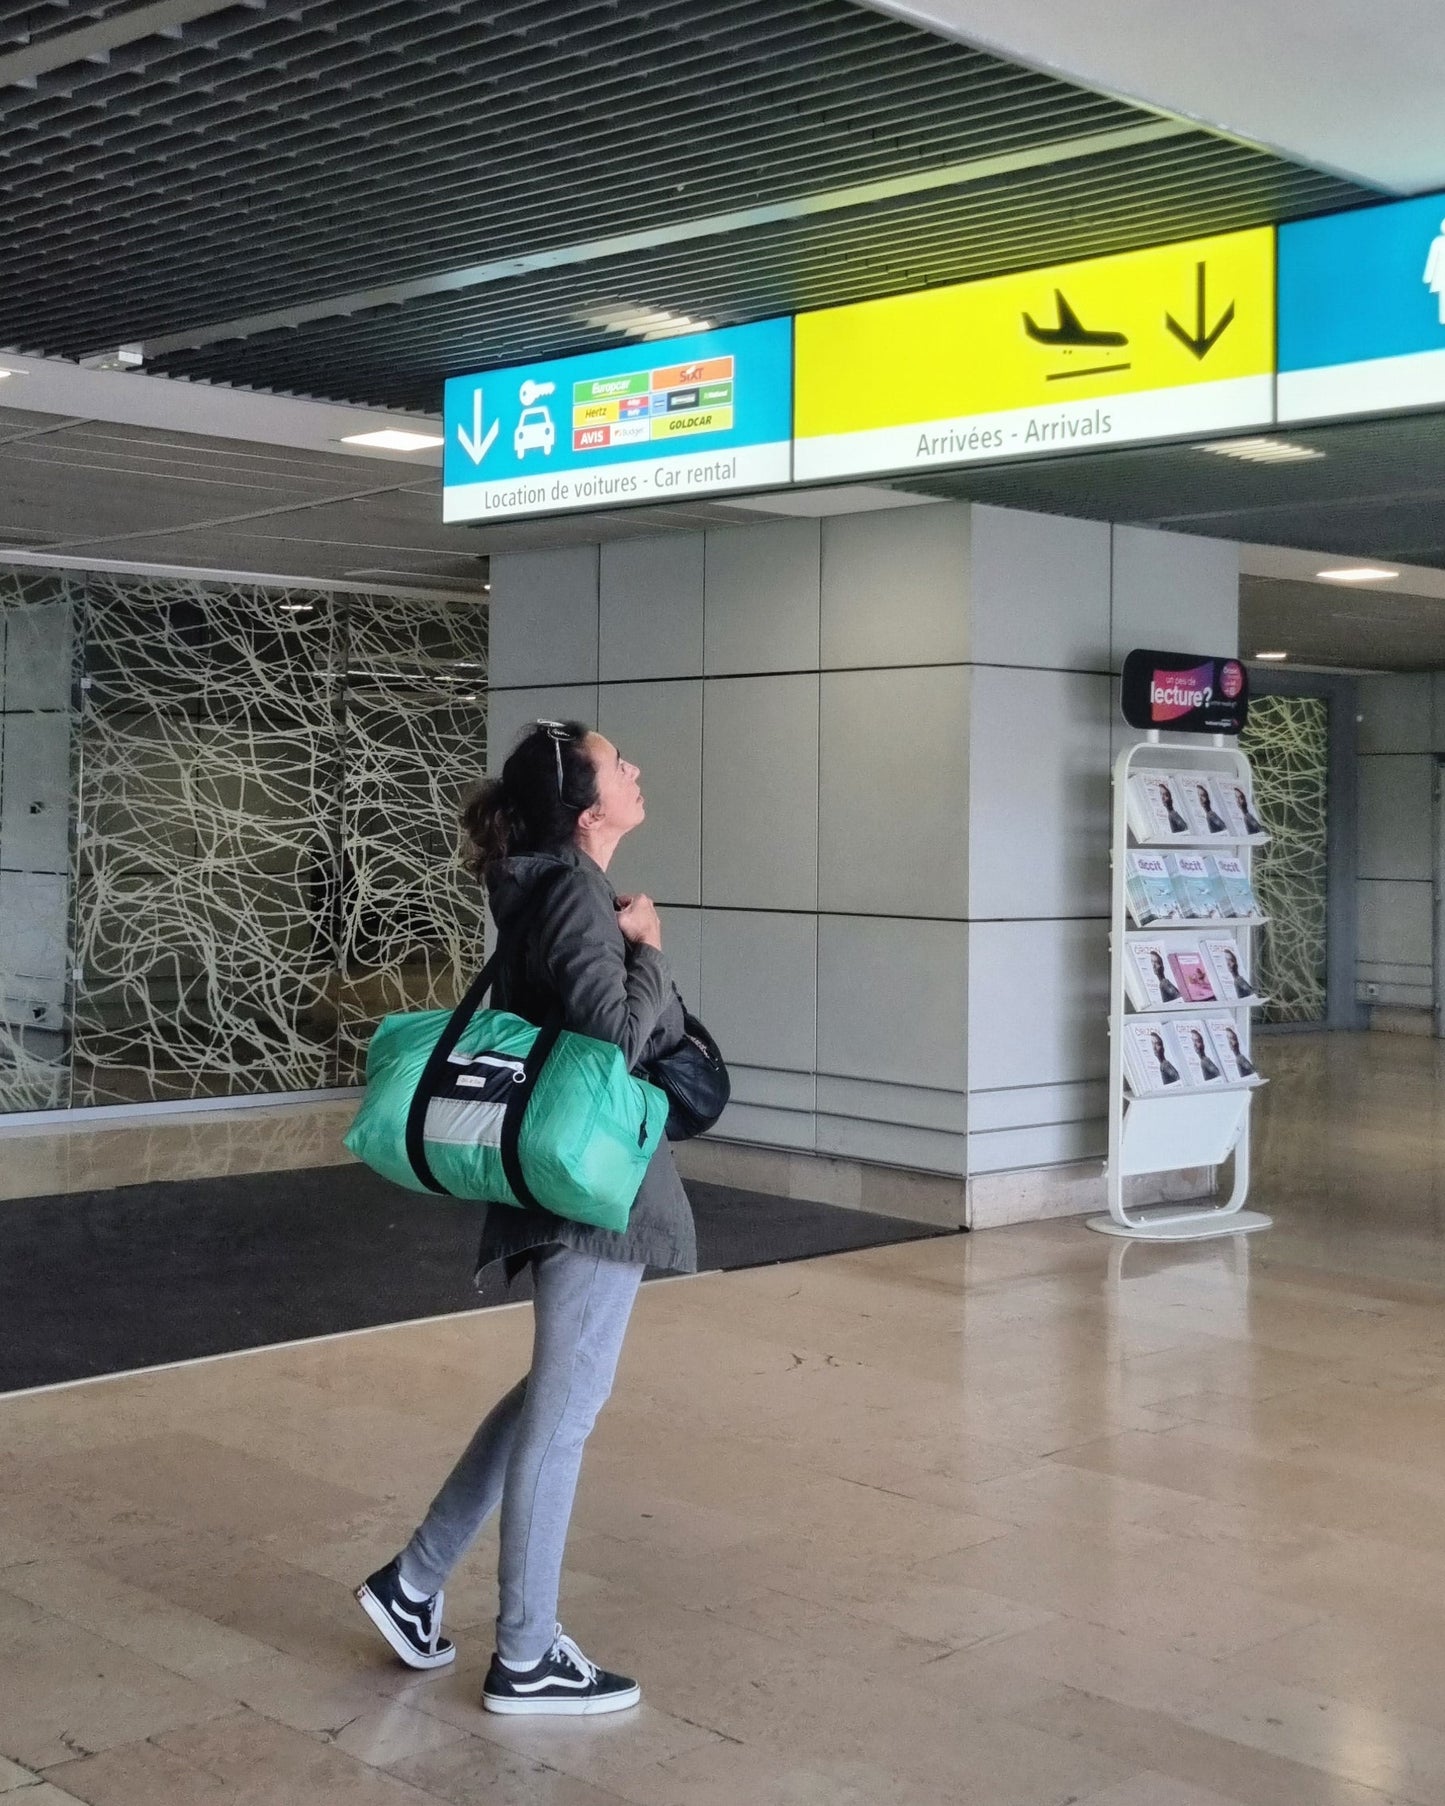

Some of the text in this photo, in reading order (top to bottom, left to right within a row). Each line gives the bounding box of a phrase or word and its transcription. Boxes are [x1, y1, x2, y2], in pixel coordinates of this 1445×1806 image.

[591, 379, 631, 395] Europcar
[585, 407, 607, 418] Hertz
[669, 415, 712, 430] GOLDCAR
[580, 430, 604, 445] AVIS
[916, 426, 1003, 457] Arrivées
[1024, 409, 1112, 443] Arrivals
[484, 485, 546, 510] Location
[551, 480, 569, 500] de
[574, 475, 638, 498] voitures
[654, 467, 681, 488] Car
[687, 457, 737, 484] rental
[1150, 680, 1213, 708] lecture?
